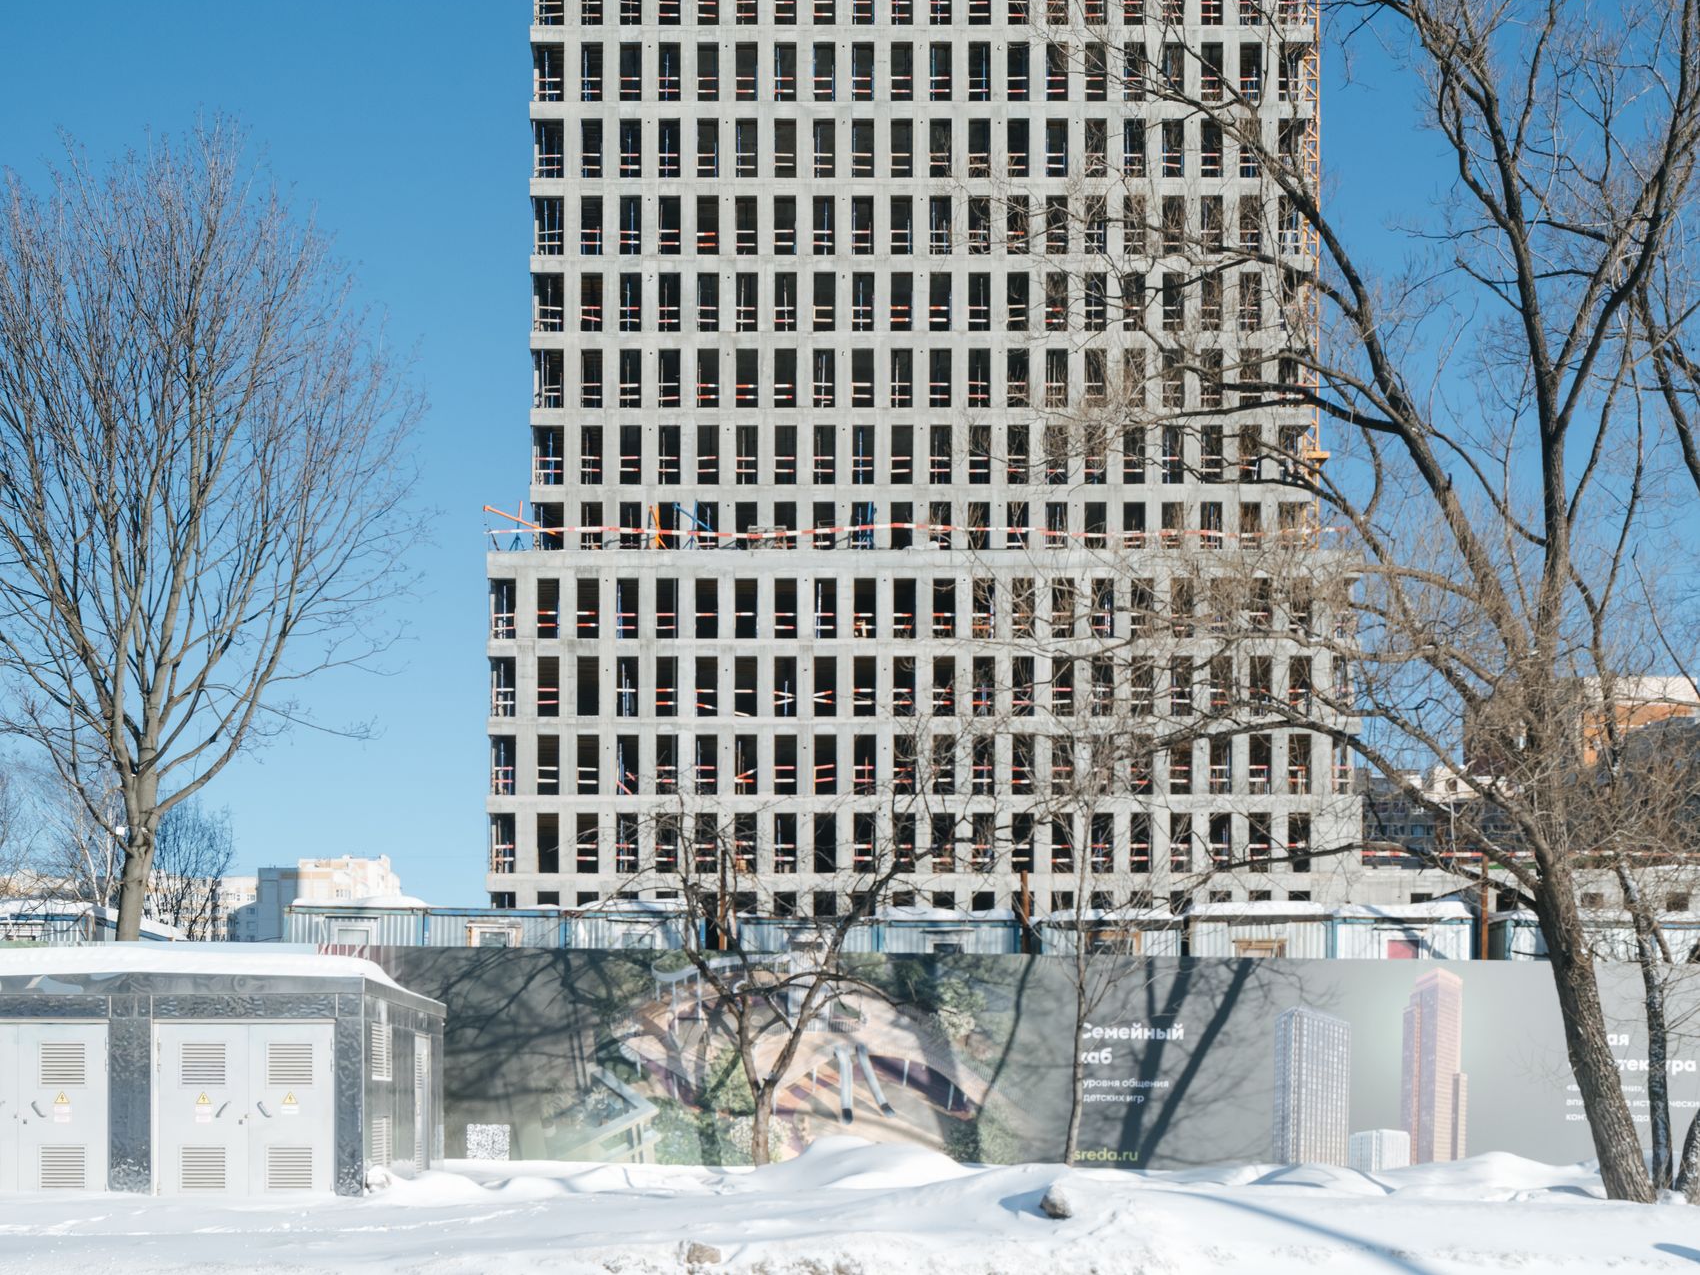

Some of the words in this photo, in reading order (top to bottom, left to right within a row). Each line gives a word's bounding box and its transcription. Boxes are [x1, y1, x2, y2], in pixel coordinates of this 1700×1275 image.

[1082, 1079, 1121, 1088] уровня
[1122, 1078, 1169, 1088] общения
[1083, 1094, 1124, 1102] детских
[1126, 1095, 1145, 1104] игр
[1073, 1147, 1139, 1161] sreda.ru
